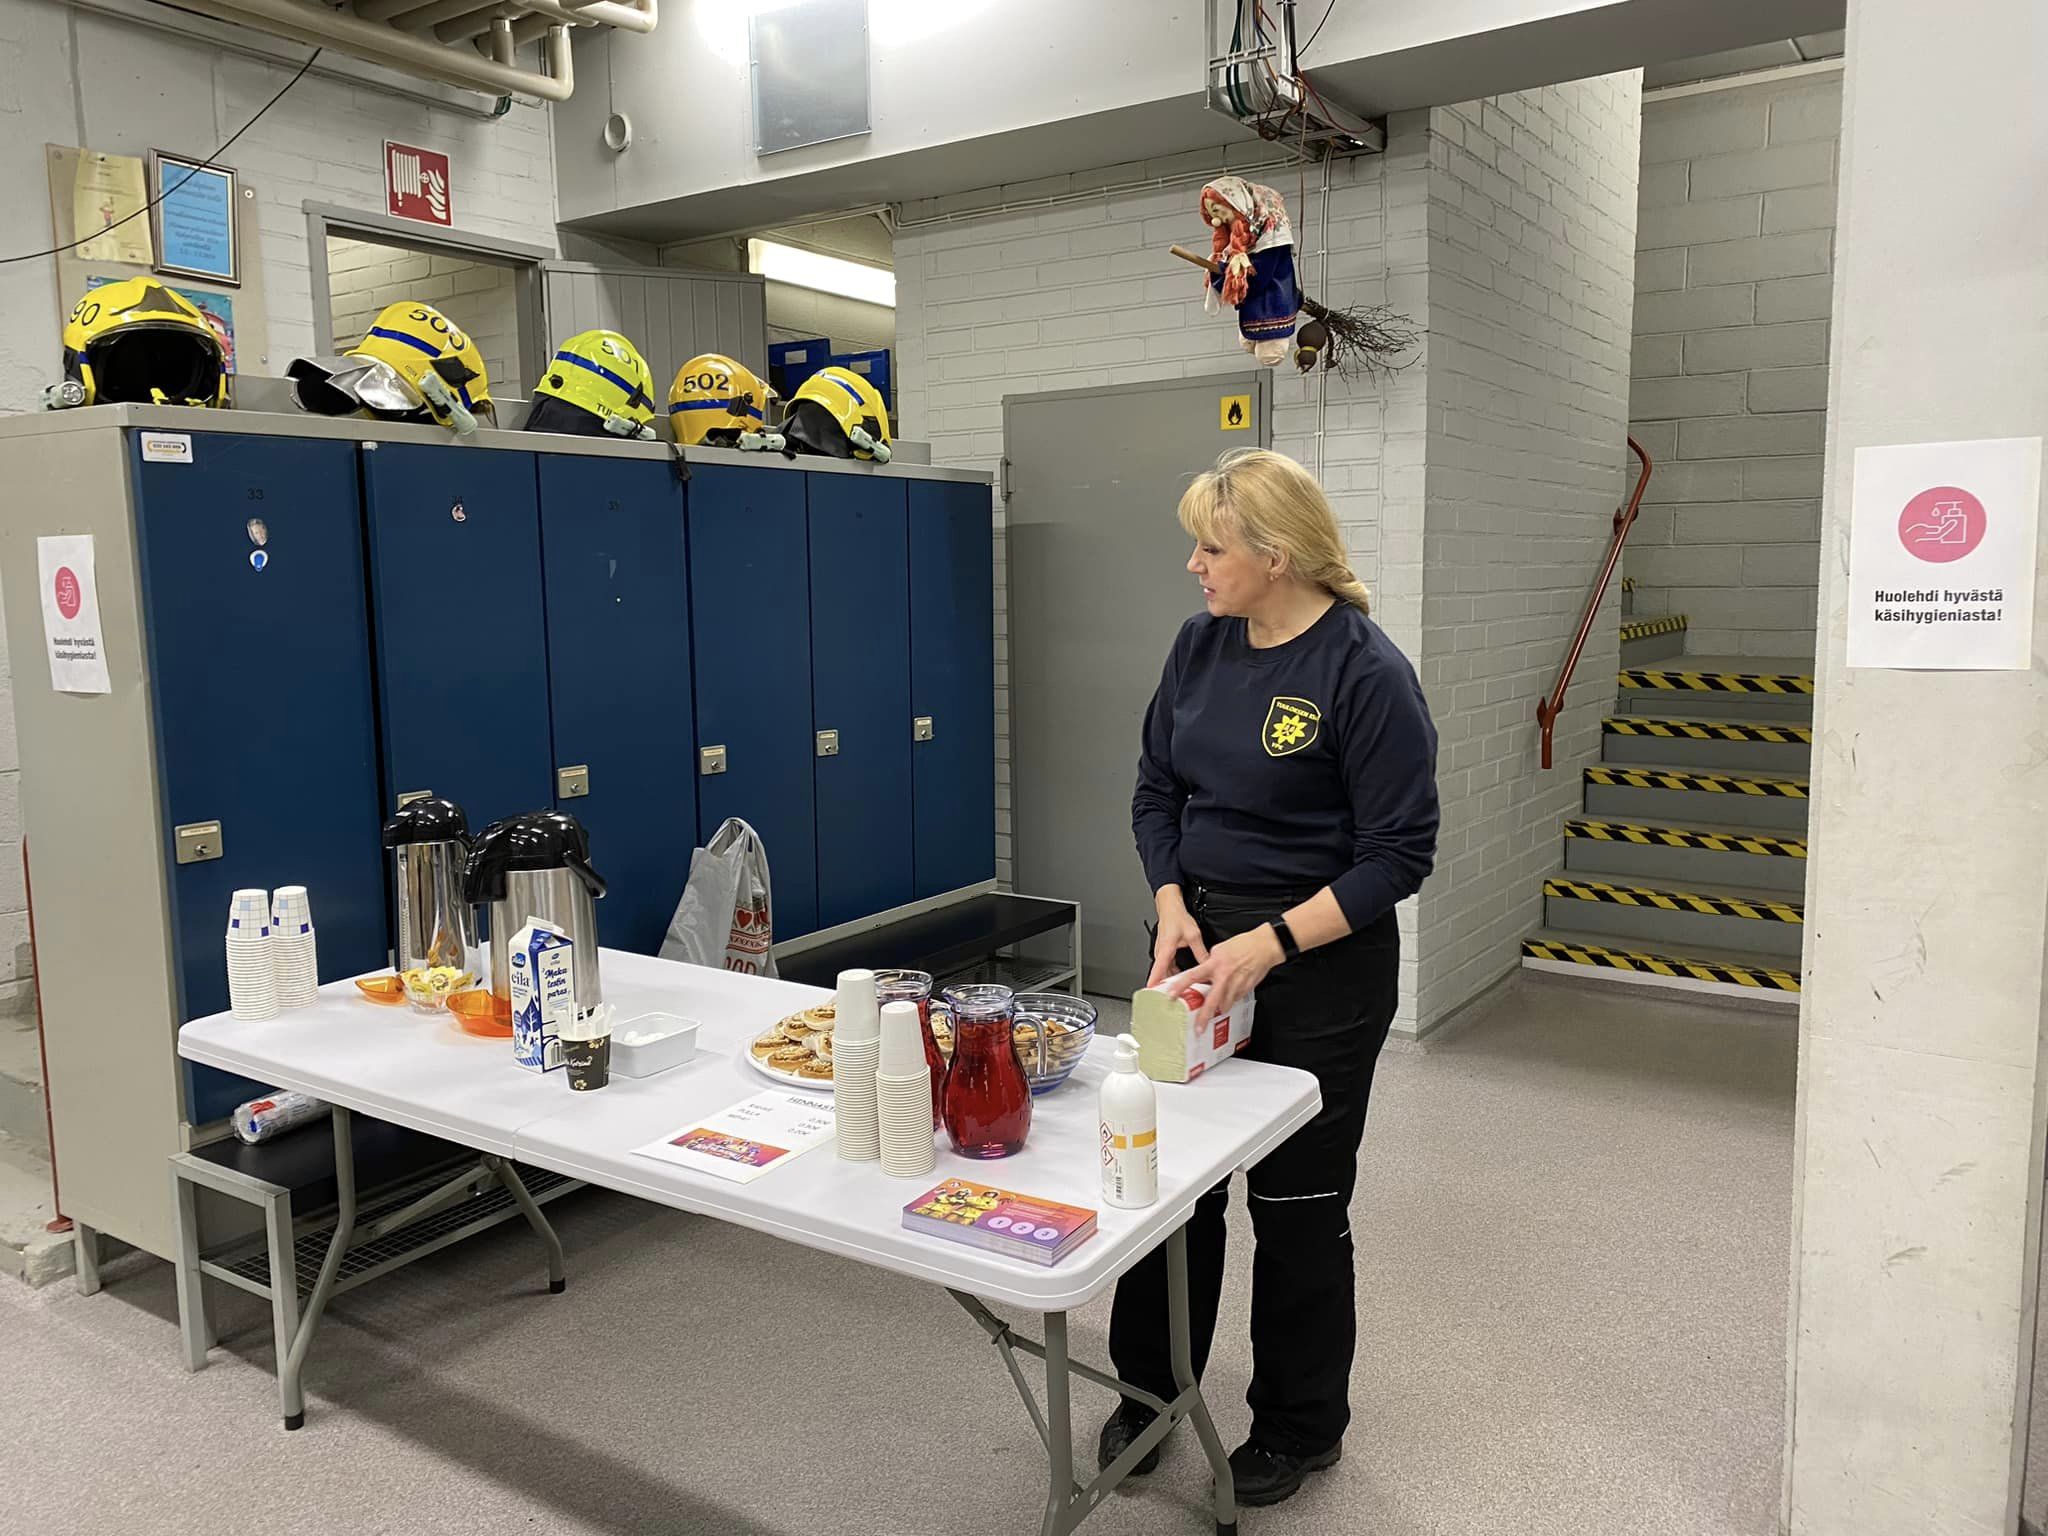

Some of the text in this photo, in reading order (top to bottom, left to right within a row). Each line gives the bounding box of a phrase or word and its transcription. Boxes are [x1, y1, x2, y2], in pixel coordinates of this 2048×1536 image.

[683, 373, 730, 394] 502
[247, 487, 264, 500] 33
[1874, 588, 2003, 604] Huolehdi hyvästä
[1874, 608, 2002, 624] käsihygieniasta!
[511, 971, 530, 987] eila
